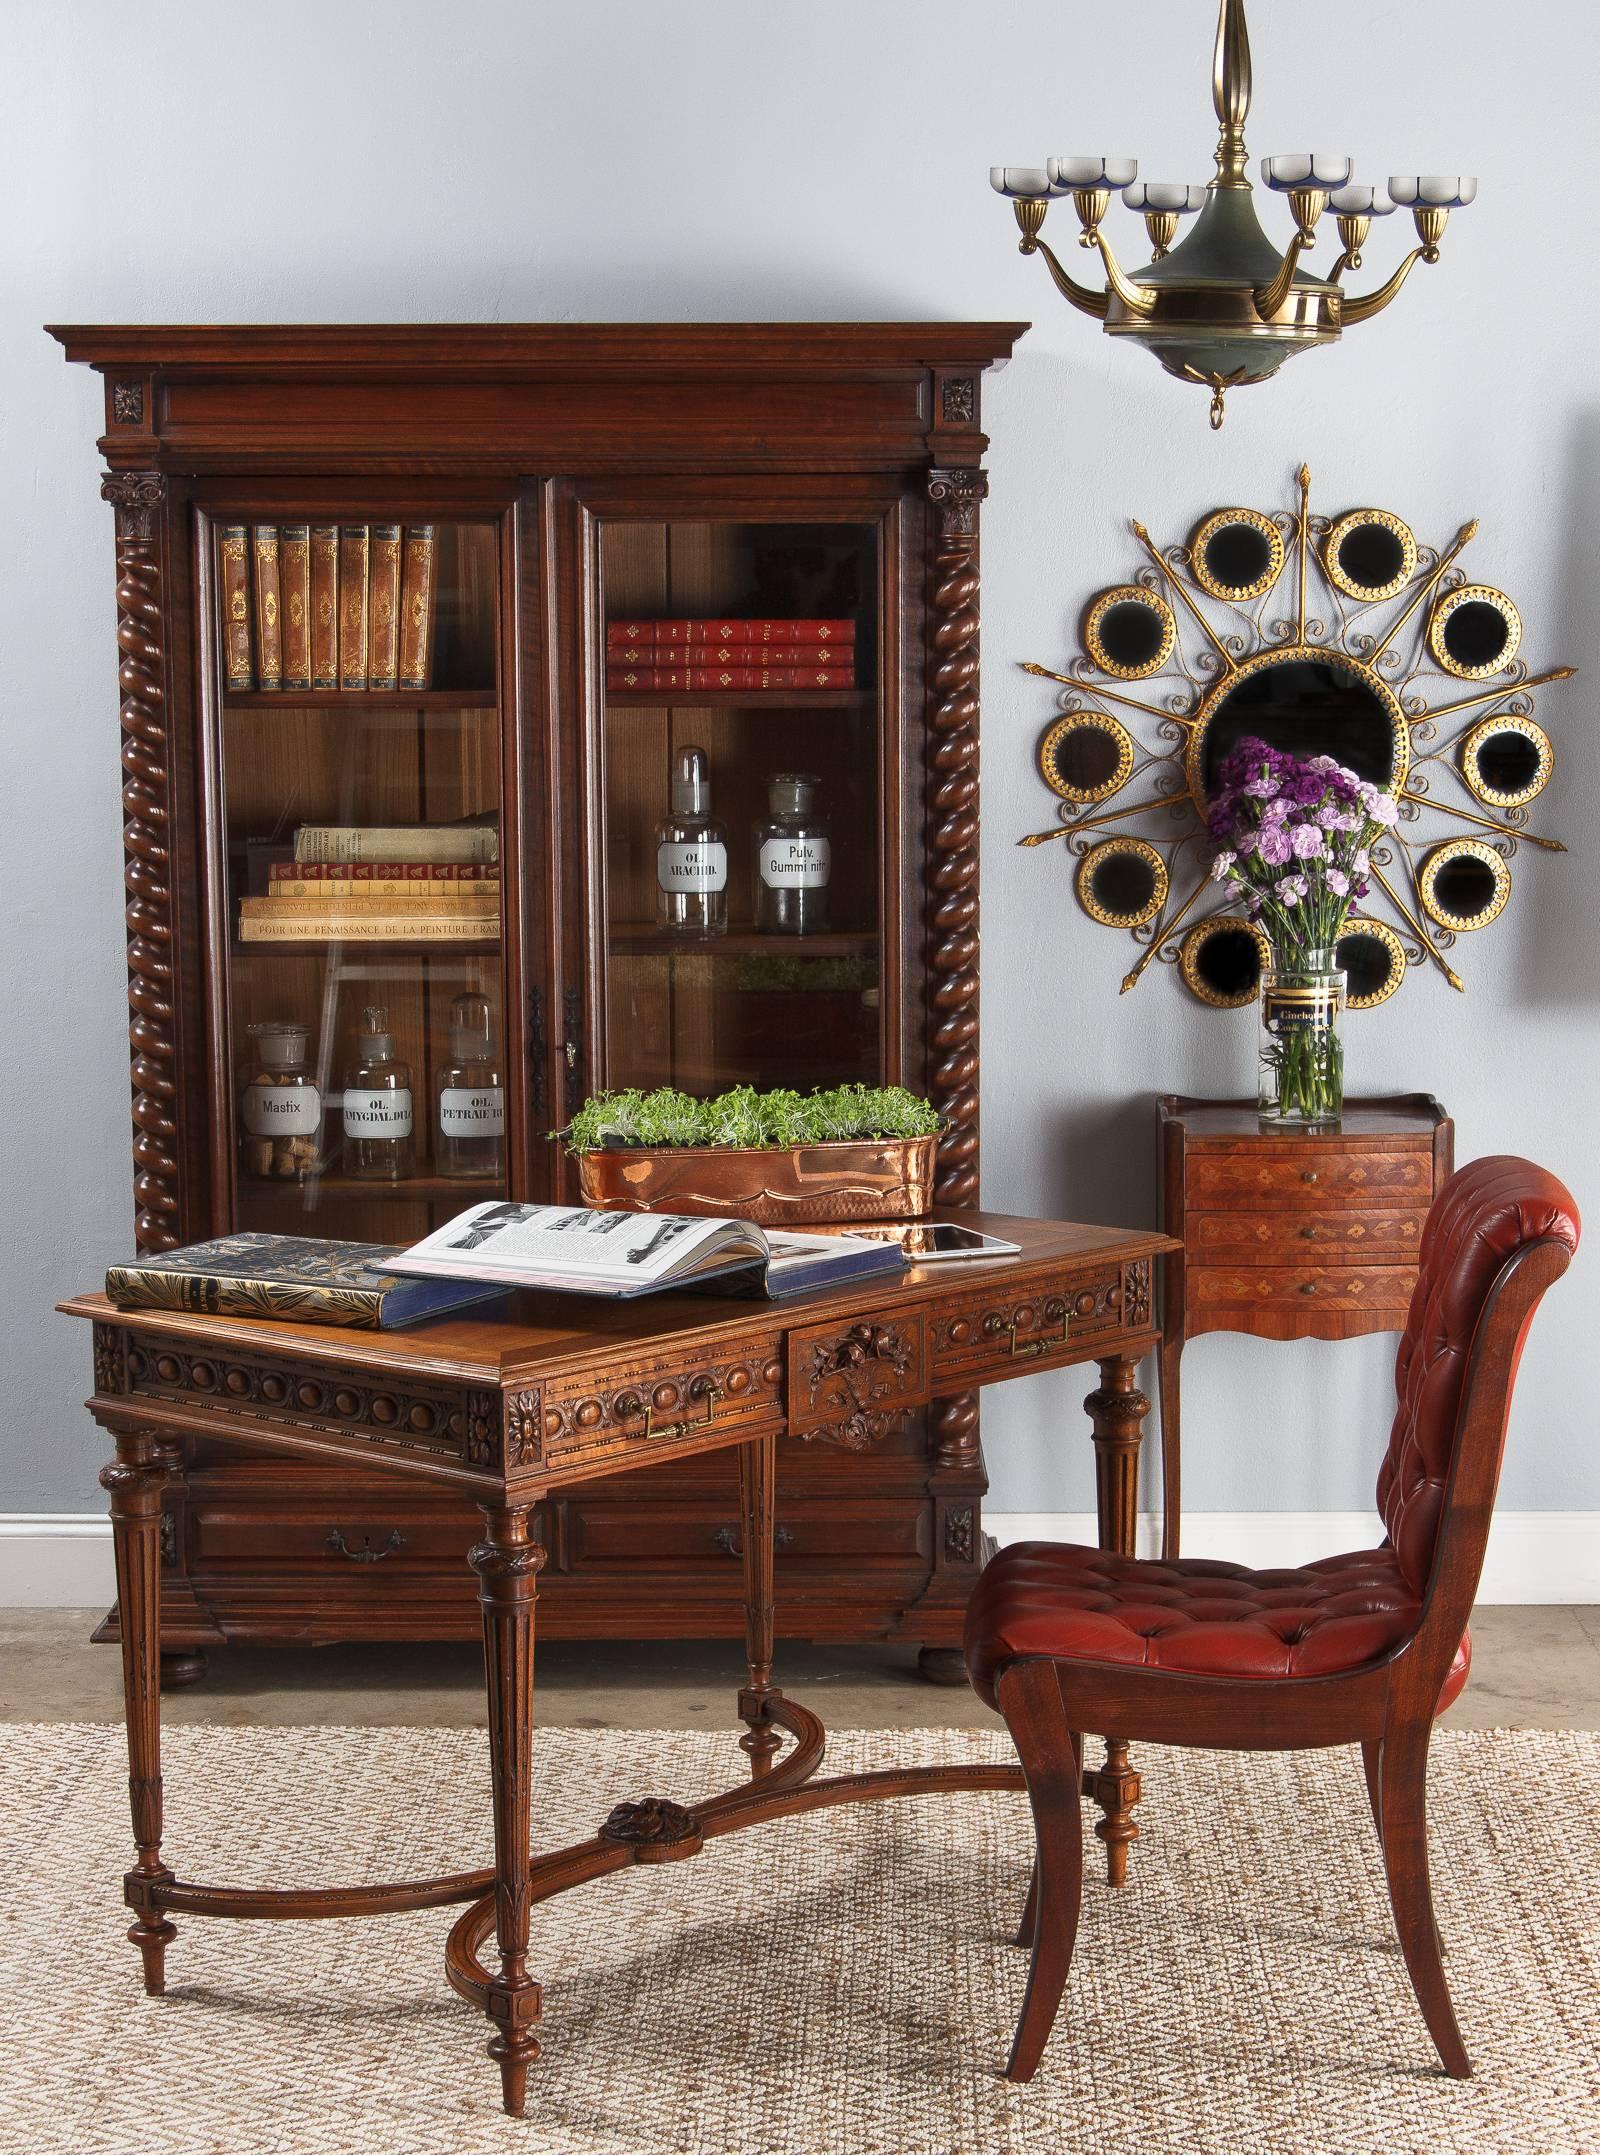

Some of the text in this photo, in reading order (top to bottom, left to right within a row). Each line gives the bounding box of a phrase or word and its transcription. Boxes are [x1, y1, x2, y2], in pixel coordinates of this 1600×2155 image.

[790, 846, 814, 858] Pulv.
[770, 860, 807, 872] Gummi
[259, 925, 286, 935] POUR
[290, 925, 310, 935] UNE
[315, 925, 379, 935] RENAISSANCE
[385, 925, 397, 935] DE
[402, 925, 416, 935] LA
[420, 925, 468, 935] PEINTURE
[264, 1100, 301, 1113] Mastix
[370, 1100, 389, 1110] OL.
